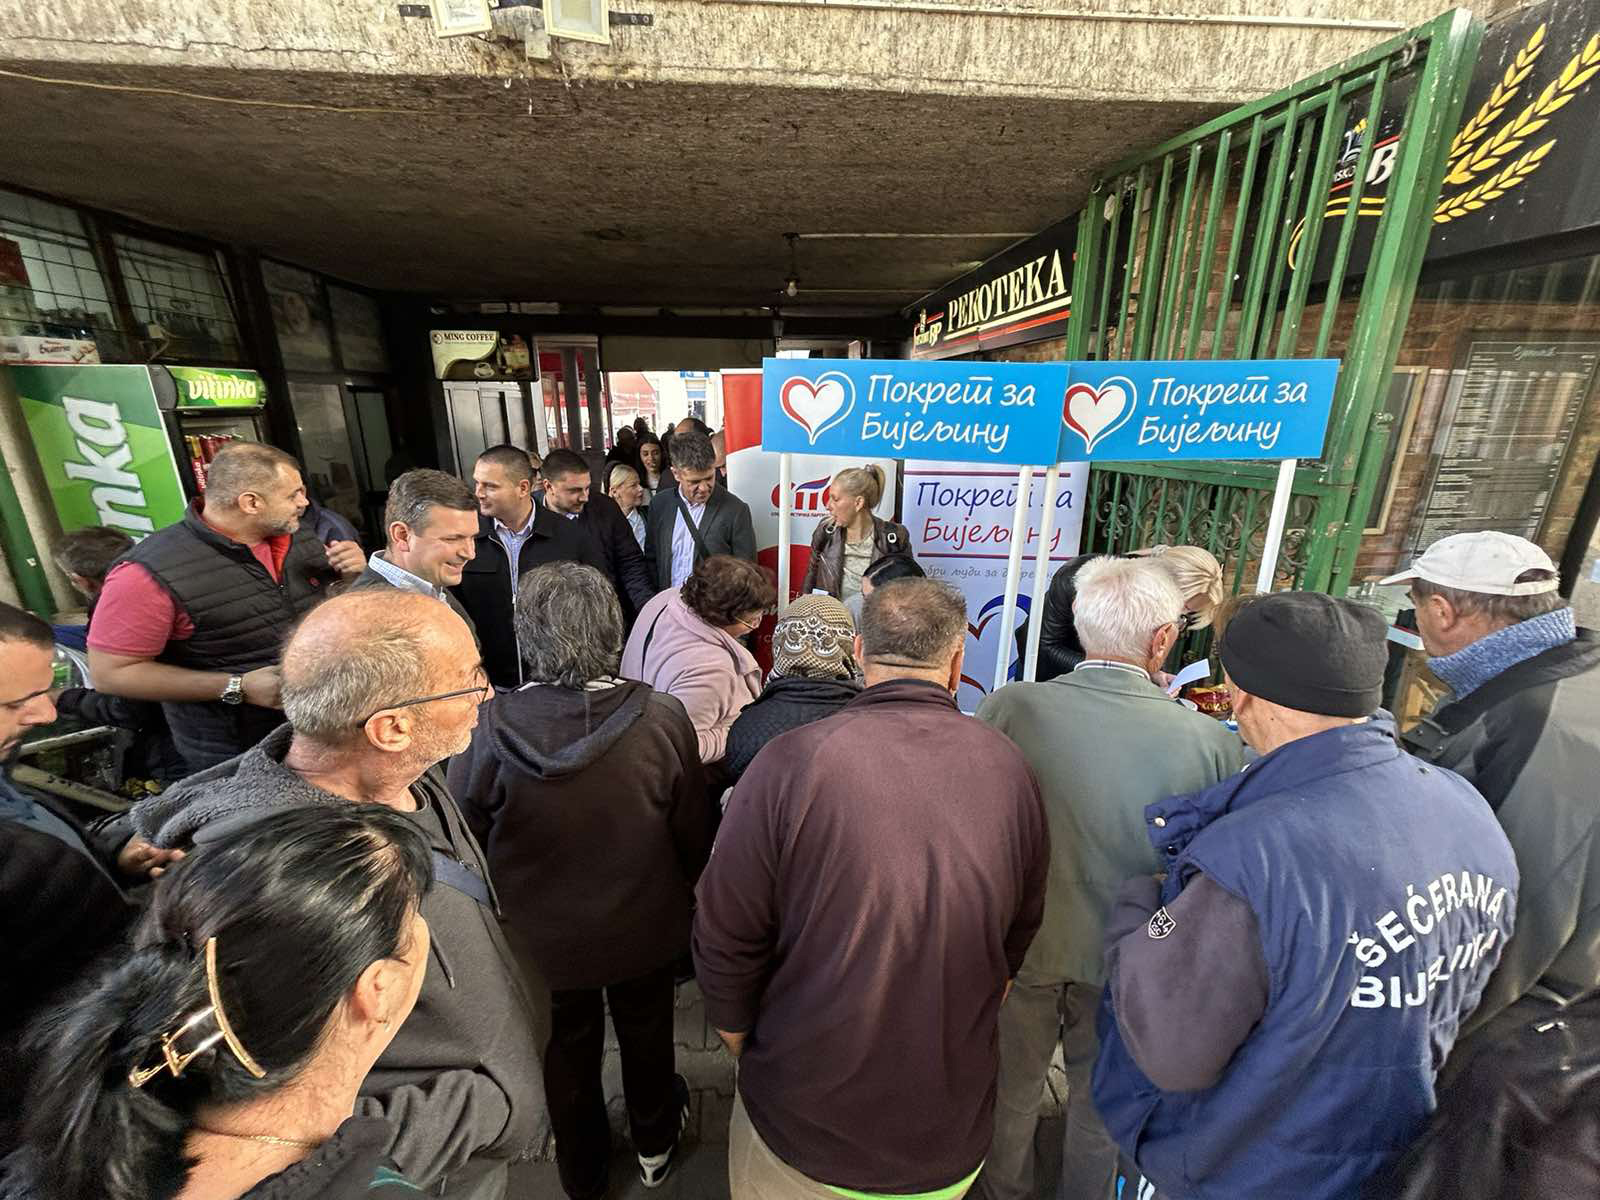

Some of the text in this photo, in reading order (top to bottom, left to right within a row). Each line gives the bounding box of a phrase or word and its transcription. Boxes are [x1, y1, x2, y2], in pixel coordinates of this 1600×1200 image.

[947, 248, 1067, 332] PEKOTEKA
[444, 332, 495, 341] MING COFFEE
[188, 375, 257, 400] vitinka
[868, 374, 1036, 415] Покрет за
[1148, 375, 1309, 416] Покрет за
[861, 411, 1009, 453] Бијељину
[1138, 414, 1281, 453] Бијељину
[62, 396, 155, 545] nka
[923, 517, 1062, 551] Бијељну
[985, 569, 998, 577] за
[1347, 871, 1507, 968] ŠEĆERANA
